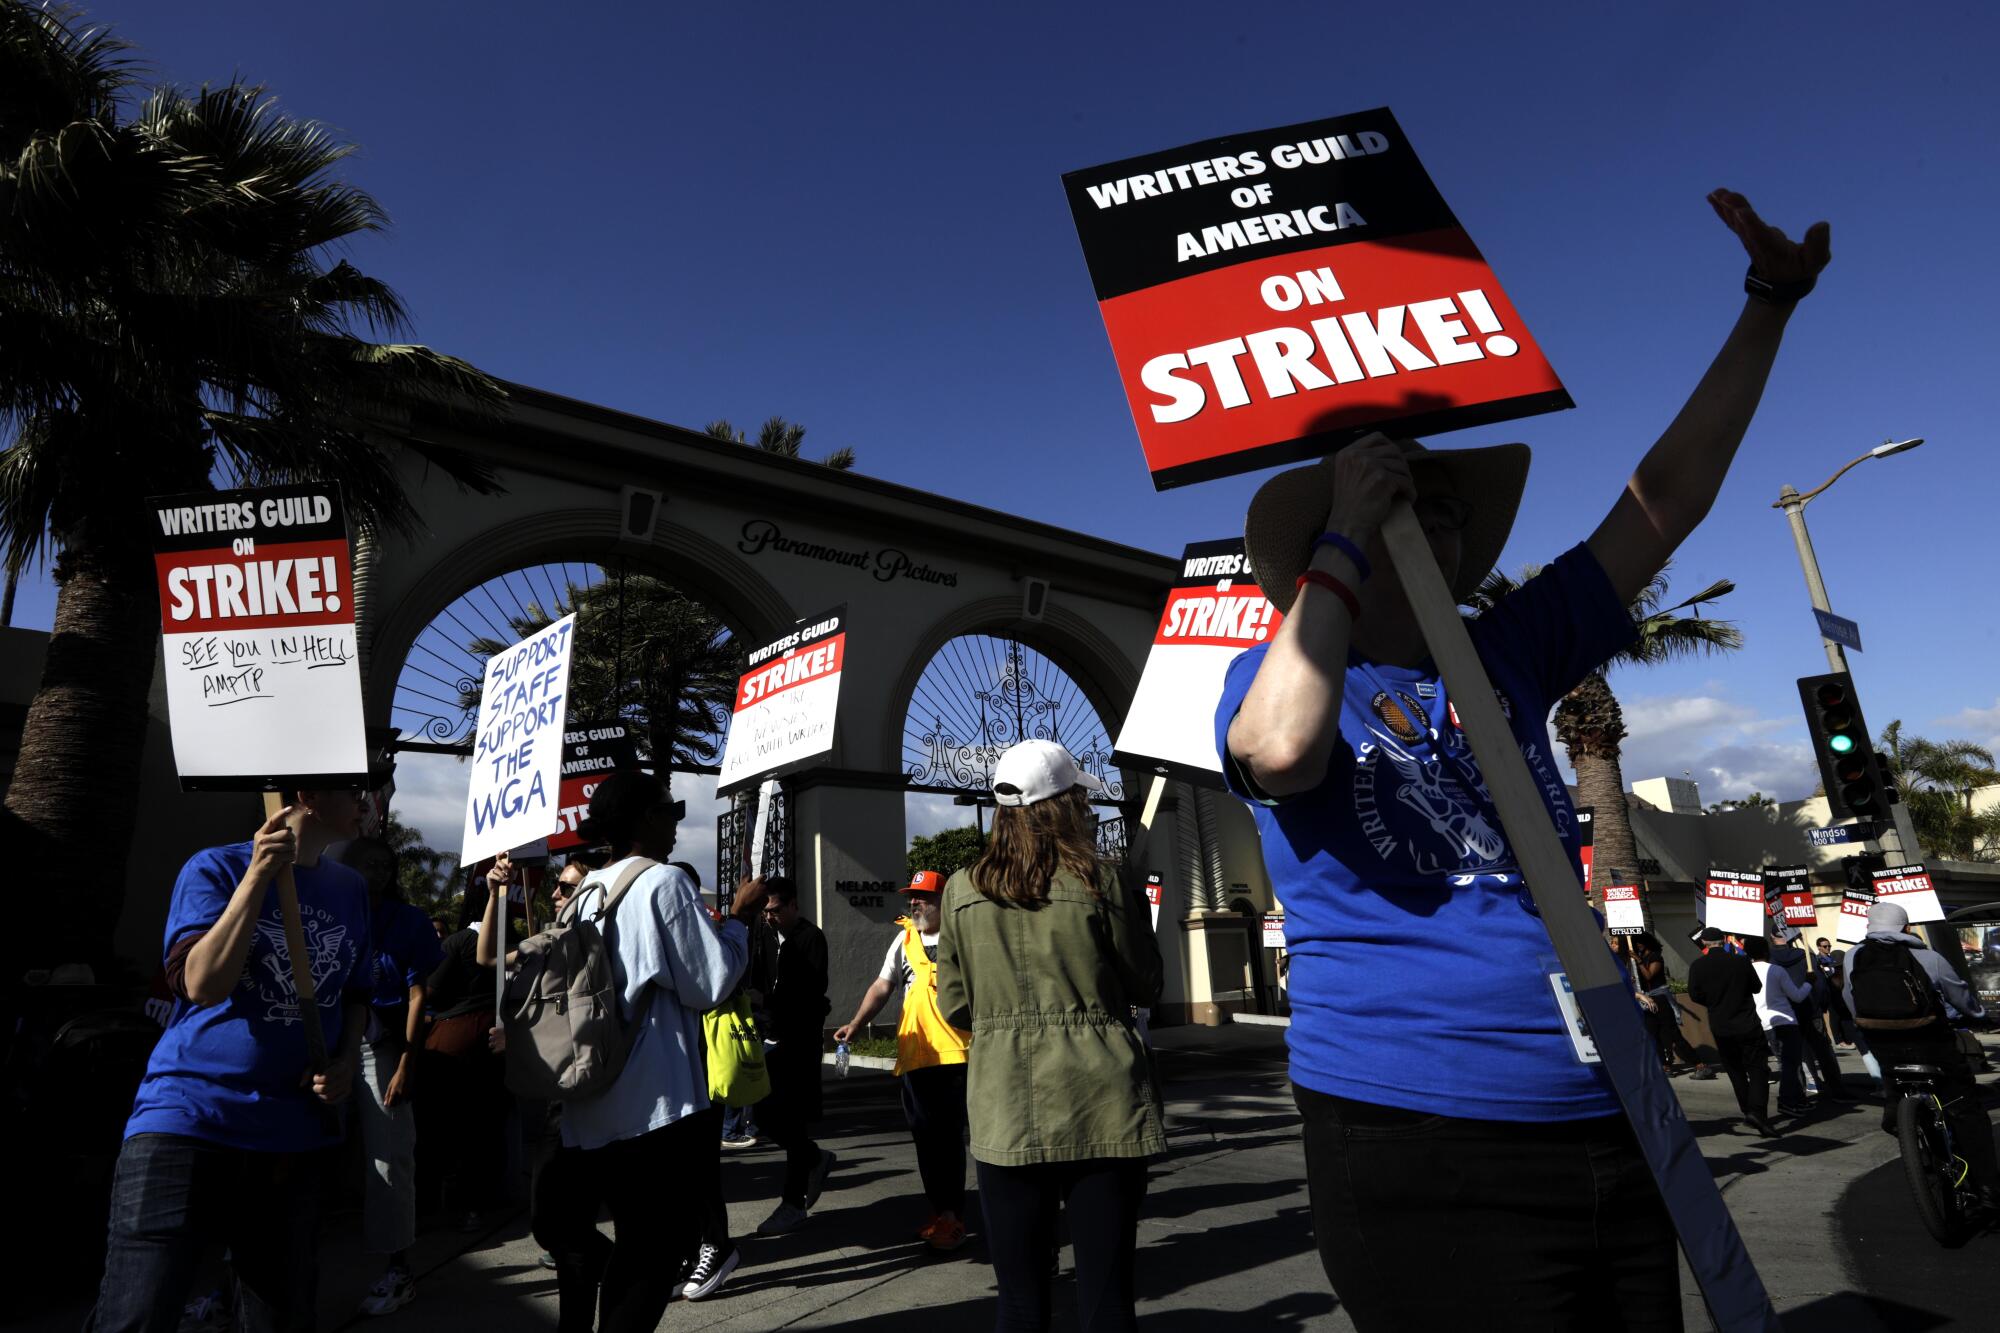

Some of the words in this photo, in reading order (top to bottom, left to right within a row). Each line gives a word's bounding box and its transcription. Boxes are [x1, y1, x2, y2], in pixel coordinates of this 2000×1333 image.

[1086, 151, 1267, 210] WRITERS
[1271, 130, 1390, 169] GUILD
[1230, 183, 1274, 209] OF
[1177, 202, 1368, 262] AMERICA
[1260, 266, 1345, 312] ON
[1140, 289, 1519, 424] STRIKE!
[157, 501, 256, 536] WRITERS
[259, 495, 331, 528] GUILD
[232, 537, 255, 557] ON
[738, 519, 870, 570] Paramount
[873, 548, 957, 587] Pictures
[1183, 554, 1243, 578] WRITERS
[167, 556, 341, 621] STRIKE!
[1216, 579, 1232, 592] ON
[1163, 596, 1275, 641] STRIKE!
[182, 637, 218, 666] SEE
[223, 639, 261, 664] YOU
[271, 639, 298, 658] IN
[303, 635, 355, 662] HELL
[749, 631, 800, 666] WRITERS
[801, 616, 839, 642] GUILD
[491, 623, 572, 694] SUPPORT
[782, 647, 796, 660] ON
[741, 641, 837, 705] STRIKE!
[486, 664, 562, 729] STAFF
[476, 695, 562, 765] SUPPORT
[588, 726, 626, 741] GUILD
[492, 739, 534, 784] THE
[575, 745, 590, 757] OF
[561, 756, 616, 775] AMERICA
[473, 770, 547, 836] WGA
[1353, 742, 1399, 861] WRITERS
[1811, 828, 1847, 840] Windso
[1814, 837, 1828, 846] 600
[1710, 870, 1740, 880] WRITERS
[1740, 872, 1762, 881] GUILD
[1778, 870, 1795, 878] WRITERS
[1872, 868, 1902, 878] WRITERS
[1902, 865, 1923, 874] GUILD
[836, 880, 897, 892] MELROSE
[1709, 883, 1761, 901] STRIKE!
[1846, 891, 1874, 902] WRITERS
[1876, 877, 1930, 894] STRIKE!
[849, 895, 884, 907] GATE
[1784, 904, 1815, 919] STRIKE!
[1611, 927, 1643, 935] STRIKE
